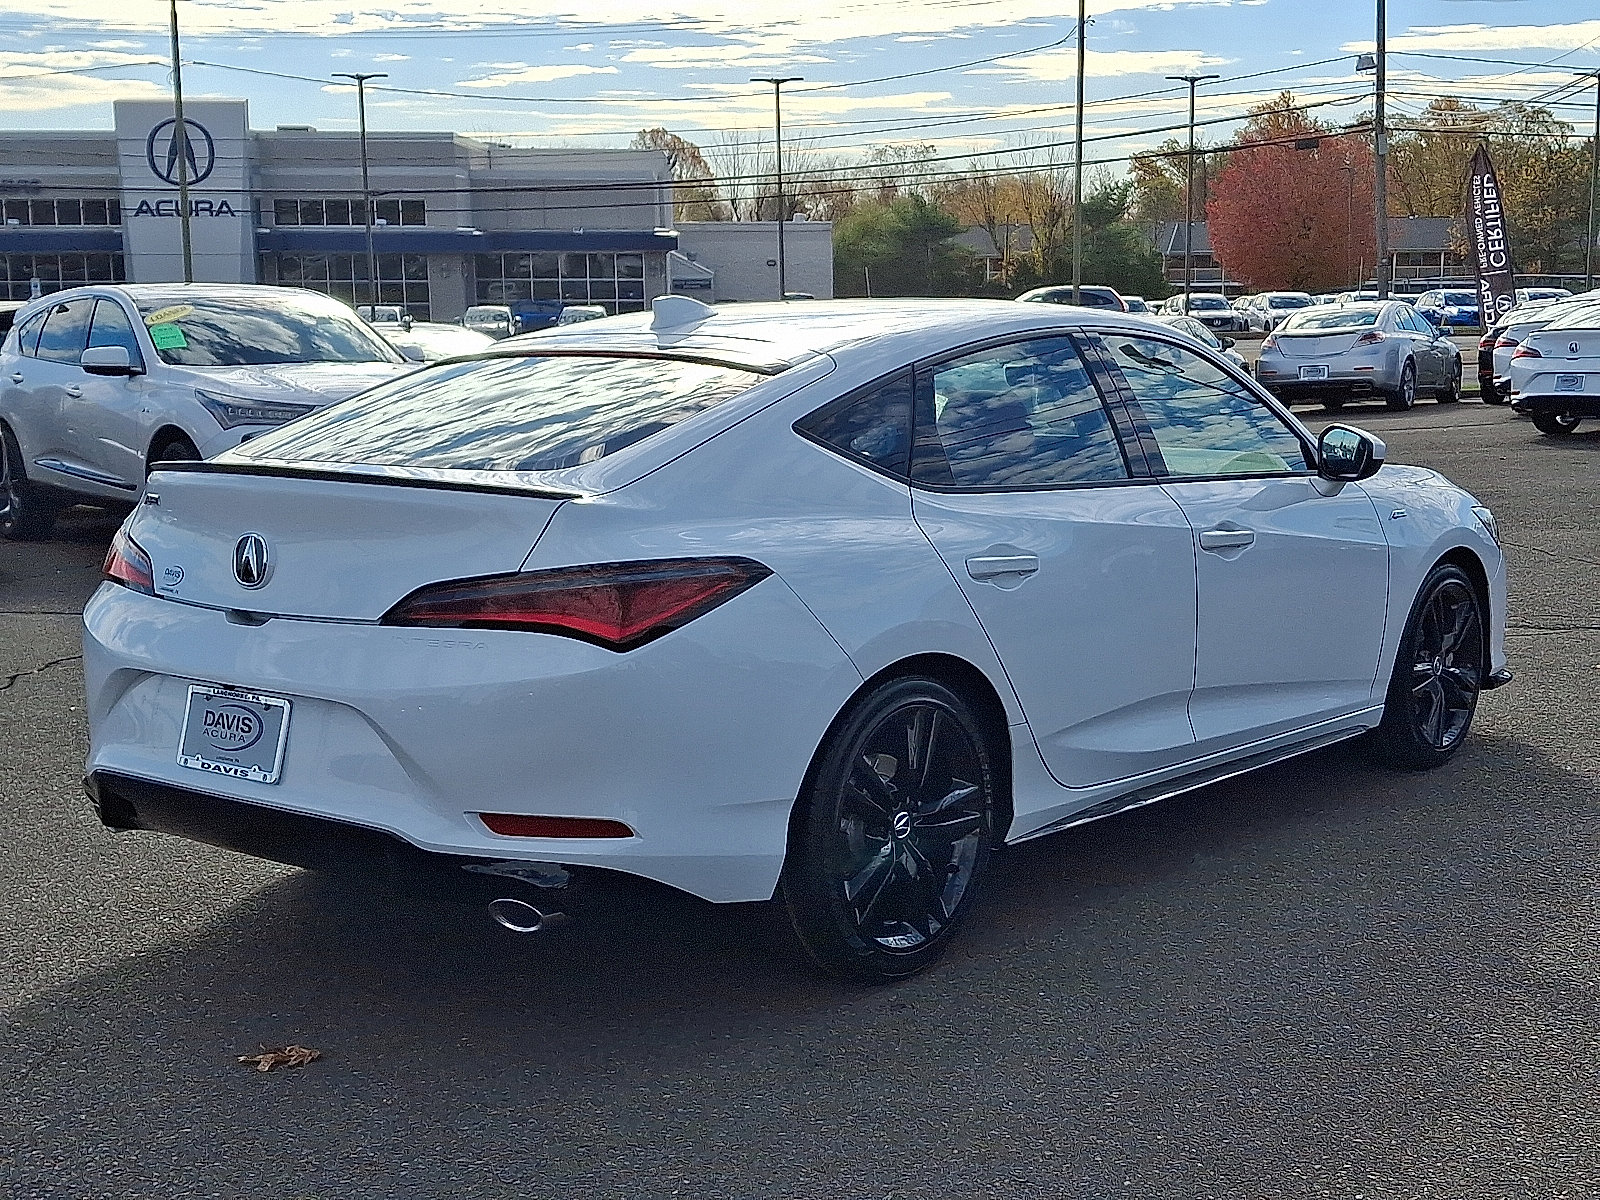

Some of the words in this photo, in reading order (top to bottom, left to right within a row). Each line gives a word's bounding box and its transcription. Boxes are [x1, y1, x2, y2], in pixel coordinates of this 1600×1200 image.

[134, 199, 236, 217] ACURA
[203, 709, 253, 734] DAVIS
[202, 727, 246, 743] ACURA
[200, 762, 249, 778] DAVIS
